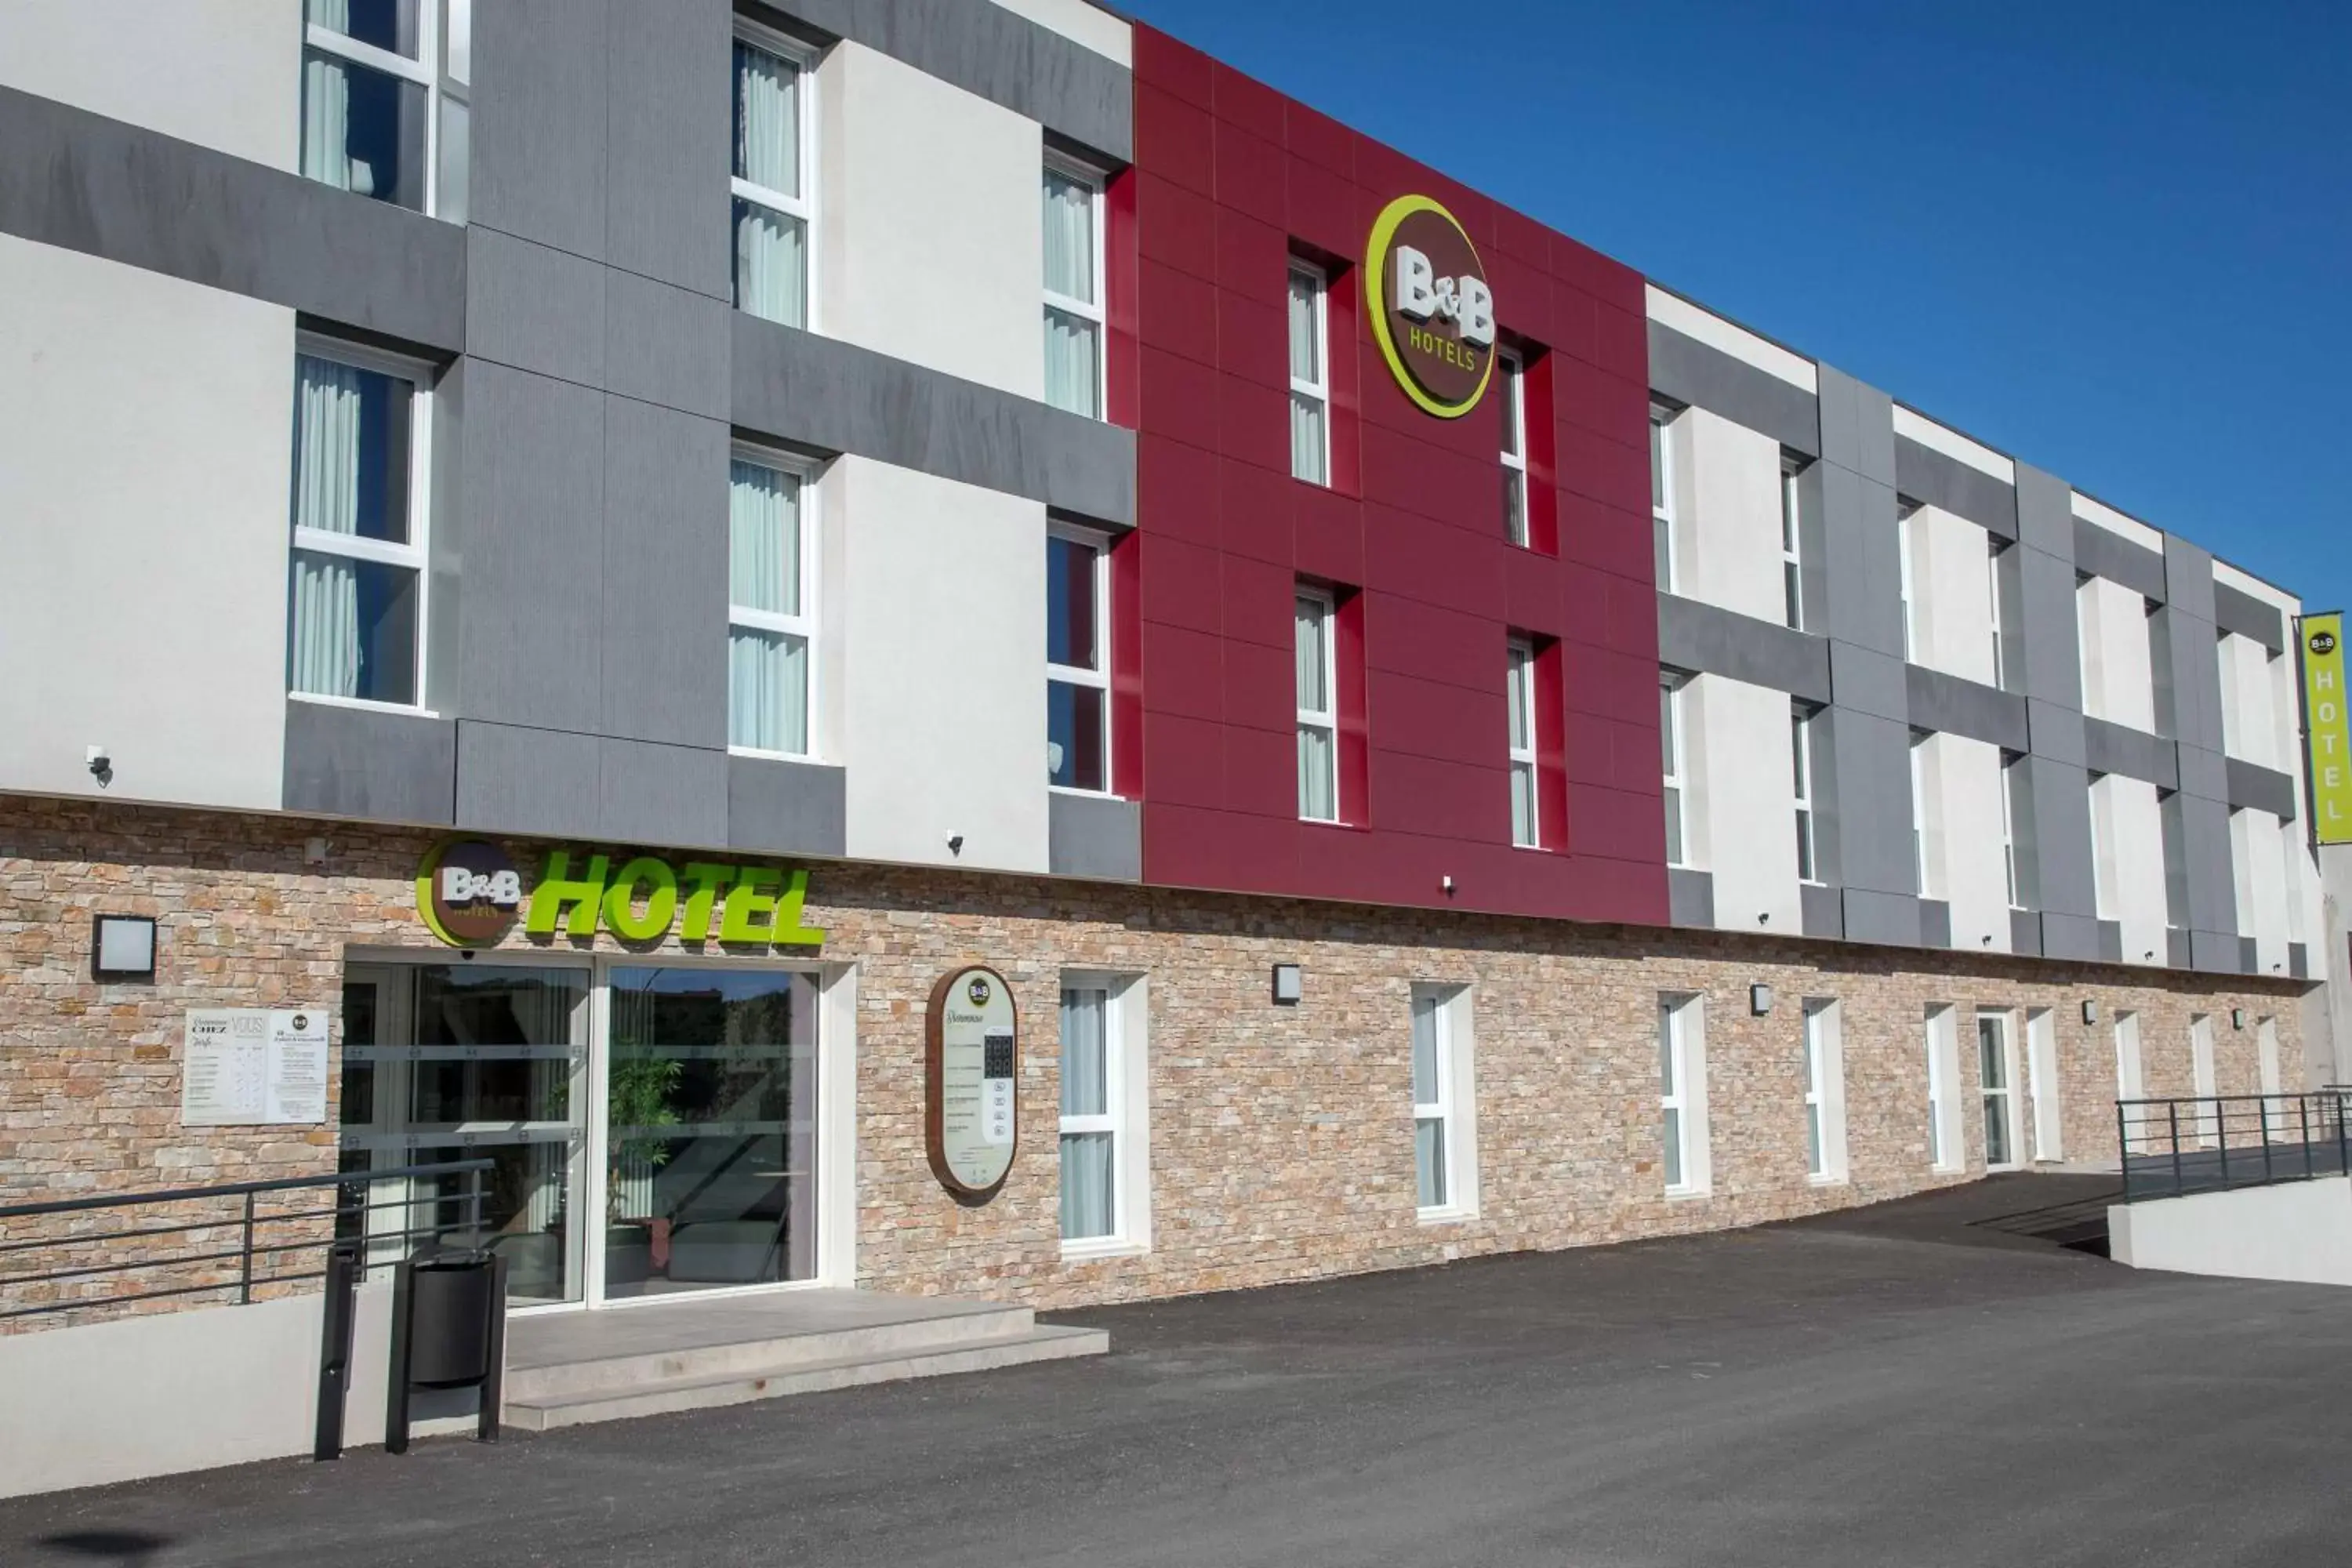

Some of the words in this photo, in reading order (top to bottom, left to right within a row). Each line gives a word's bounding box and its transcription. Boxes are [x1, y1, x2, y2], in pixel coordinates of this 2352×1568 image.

[1396, 245, 1495, 344] B&B
[1410, 326, 1475, 372] HOTELS
[2315, 670, 2343, 820] HOTEL
[441, 866, 521, 904] B&B
[526, 851, 826, 945] HOTEL
